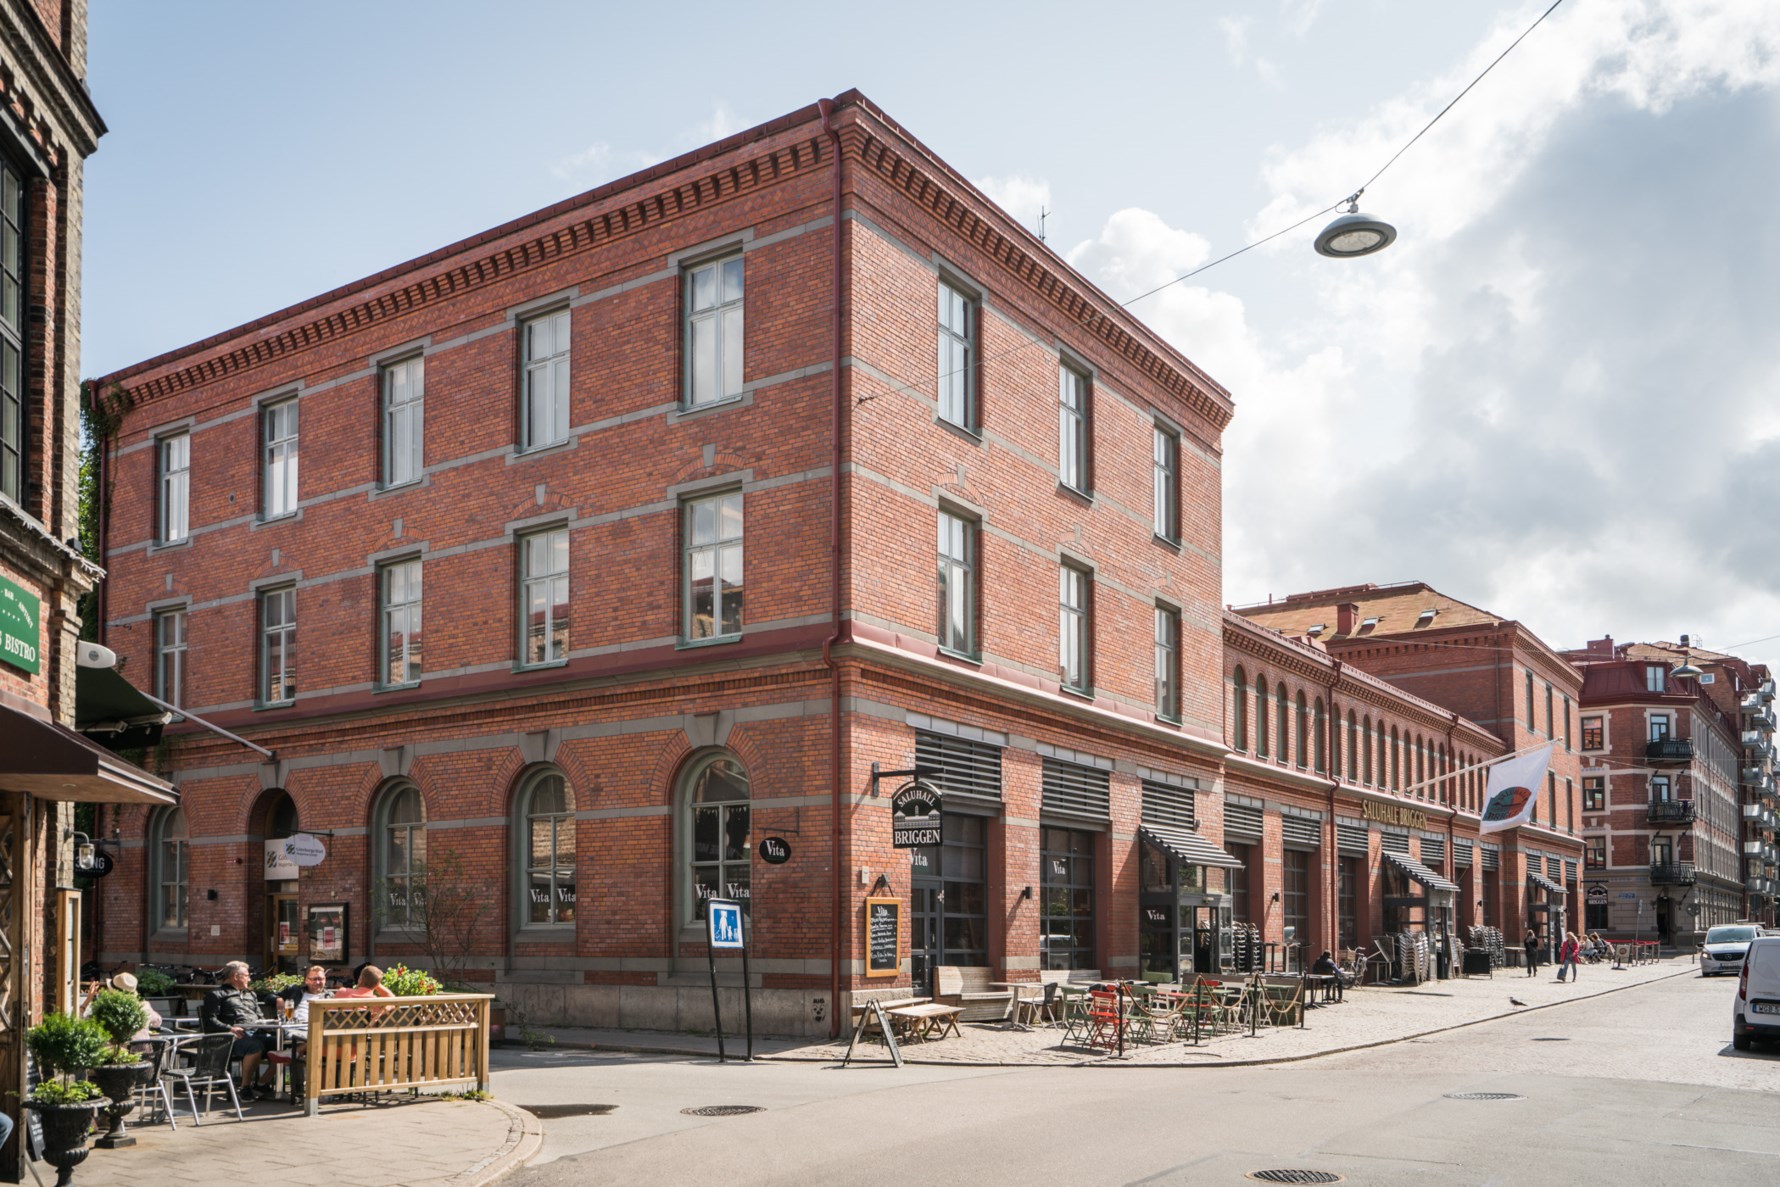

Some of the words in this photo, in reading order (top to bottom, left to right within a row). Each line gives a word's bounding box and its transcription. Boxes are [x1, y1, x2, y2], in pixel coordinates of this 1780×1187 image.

[4, 633, 36, 663] BISTRO
[897, 790, 936, 808] SALUHALL
[1400, 807, 1428, 830] BRIGGEN
[894, 829, 941, 845] BRIGGEN
[765, 839, 786, 857] Vita
[1053, 861, 1066, 875] Vita
[529, 889, 550, 903] Vita
[695, 884, 718, 899] Vita
[726, 883, 751, 898] Vita
[1146, 909, 1166, 921] Vita
